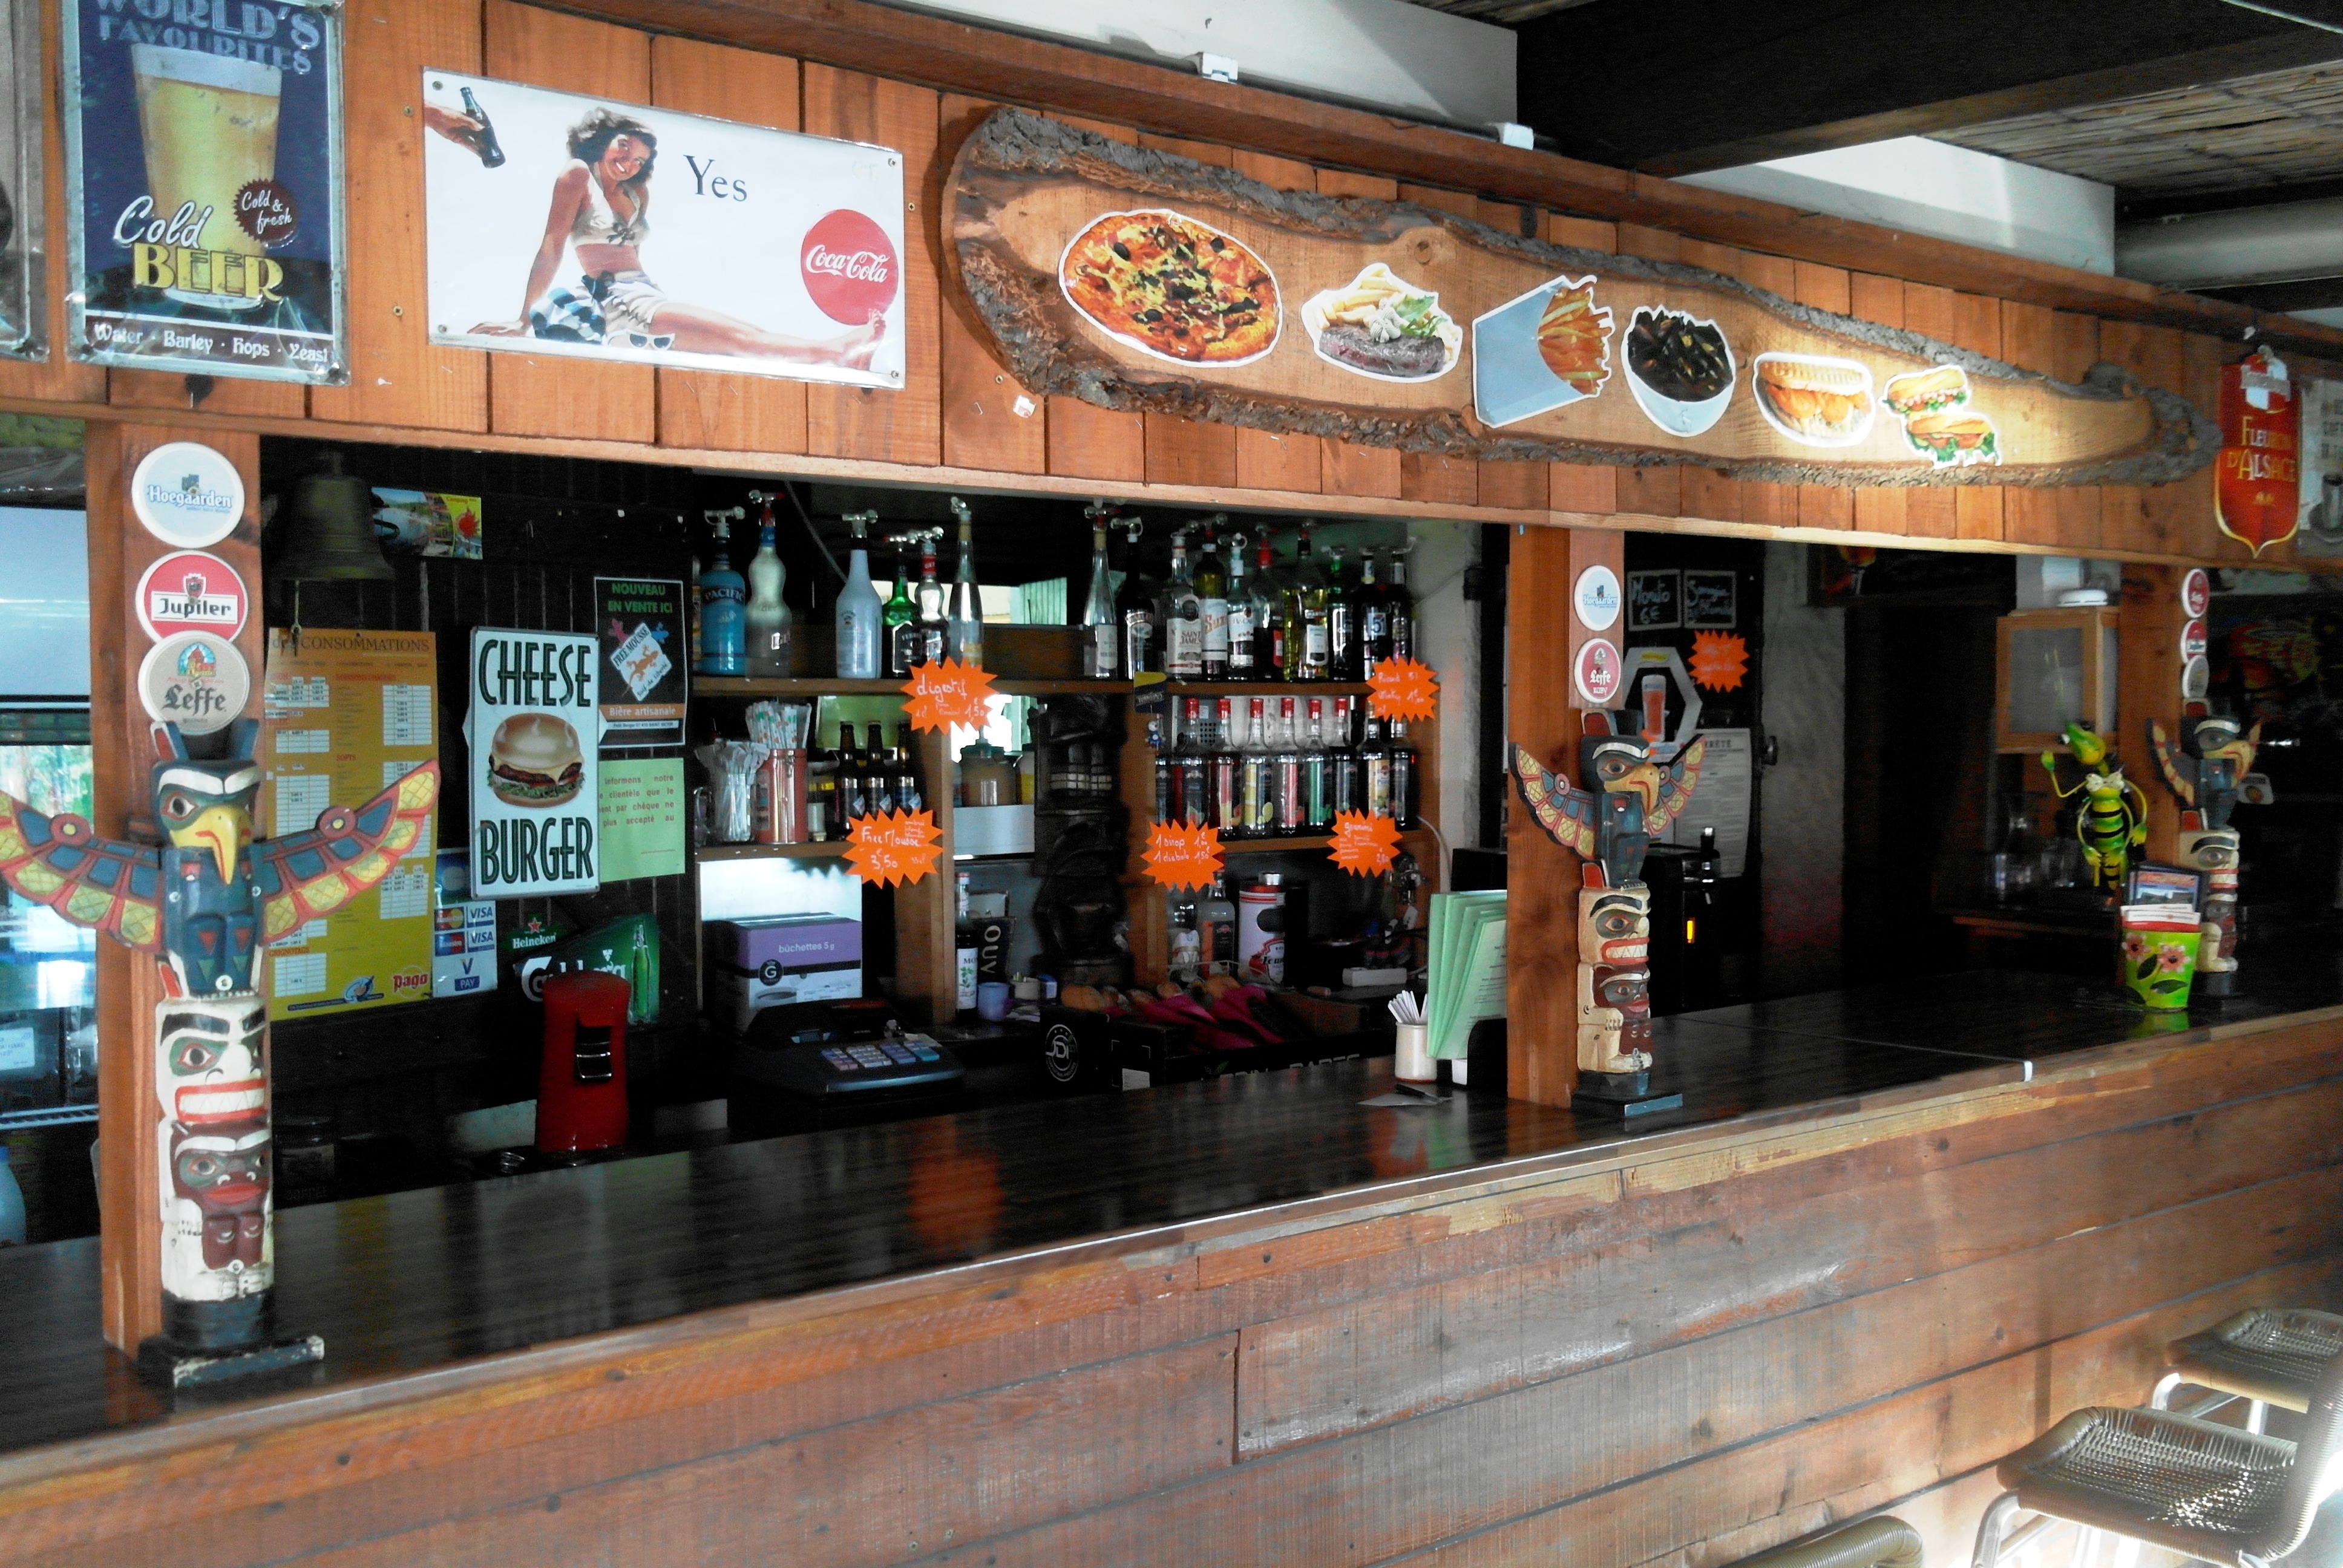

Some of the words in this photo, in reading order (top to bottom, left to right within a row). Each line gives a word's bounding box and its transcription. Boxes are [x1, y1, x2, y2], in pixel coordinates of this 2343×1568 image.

[683, 154, 748, 201] Yes
[242, 189, 271, 211] Cold
[273, 199, 283, 212] &
[114, 196, 214, 248] Cold
[257, 207, 292, 234] fresh
[133, 243, 284, 301] BEER
[806, 244, 890, 283] Coca-Cola
[94, 322, 143, 343] Water
[164, 330, 213, 353] Barley
[233, 338, 270, 358] Hops
[148, 485, 232, 508] Hoegaarden
[612, 583, 666, 596] NOUVEAU
[159, 598, 232, 618] Jupiler
[608, 600, 622, 612] EN
[624, 601, 658, 612] VENTE
[660, 603, 673, 613] ICI
[301, 637, 430, 651] CONSOMMATIONS
[613, 648, 629, 666] FREE
[626, 626, 649, 652] MOUSSE
[479, 639, 591, 707] CHEESE
[1590, 669, 1611, 685] Leffe
[162, 684, 226, 716] Leffe
[610, 706, 631, 716] Bière
[635, 706, 676, 716] artisanale
[603, 818, 617, 827] plus
[862, 826, 883, 844] Free
[1156, 834, 1162, 848] 1
[480, 817, 594, 884] BURGER
[1153, 850, 1161, 863] 1
[471, 906, 493, 918] VISA
[471, 932, 494, 943] VISA
[513, 934, 557, 949] Heineken
[765, 966, 777, 978] G
[393, 974, 428, 993] pago
[460, 979, 474, 989] PAY
